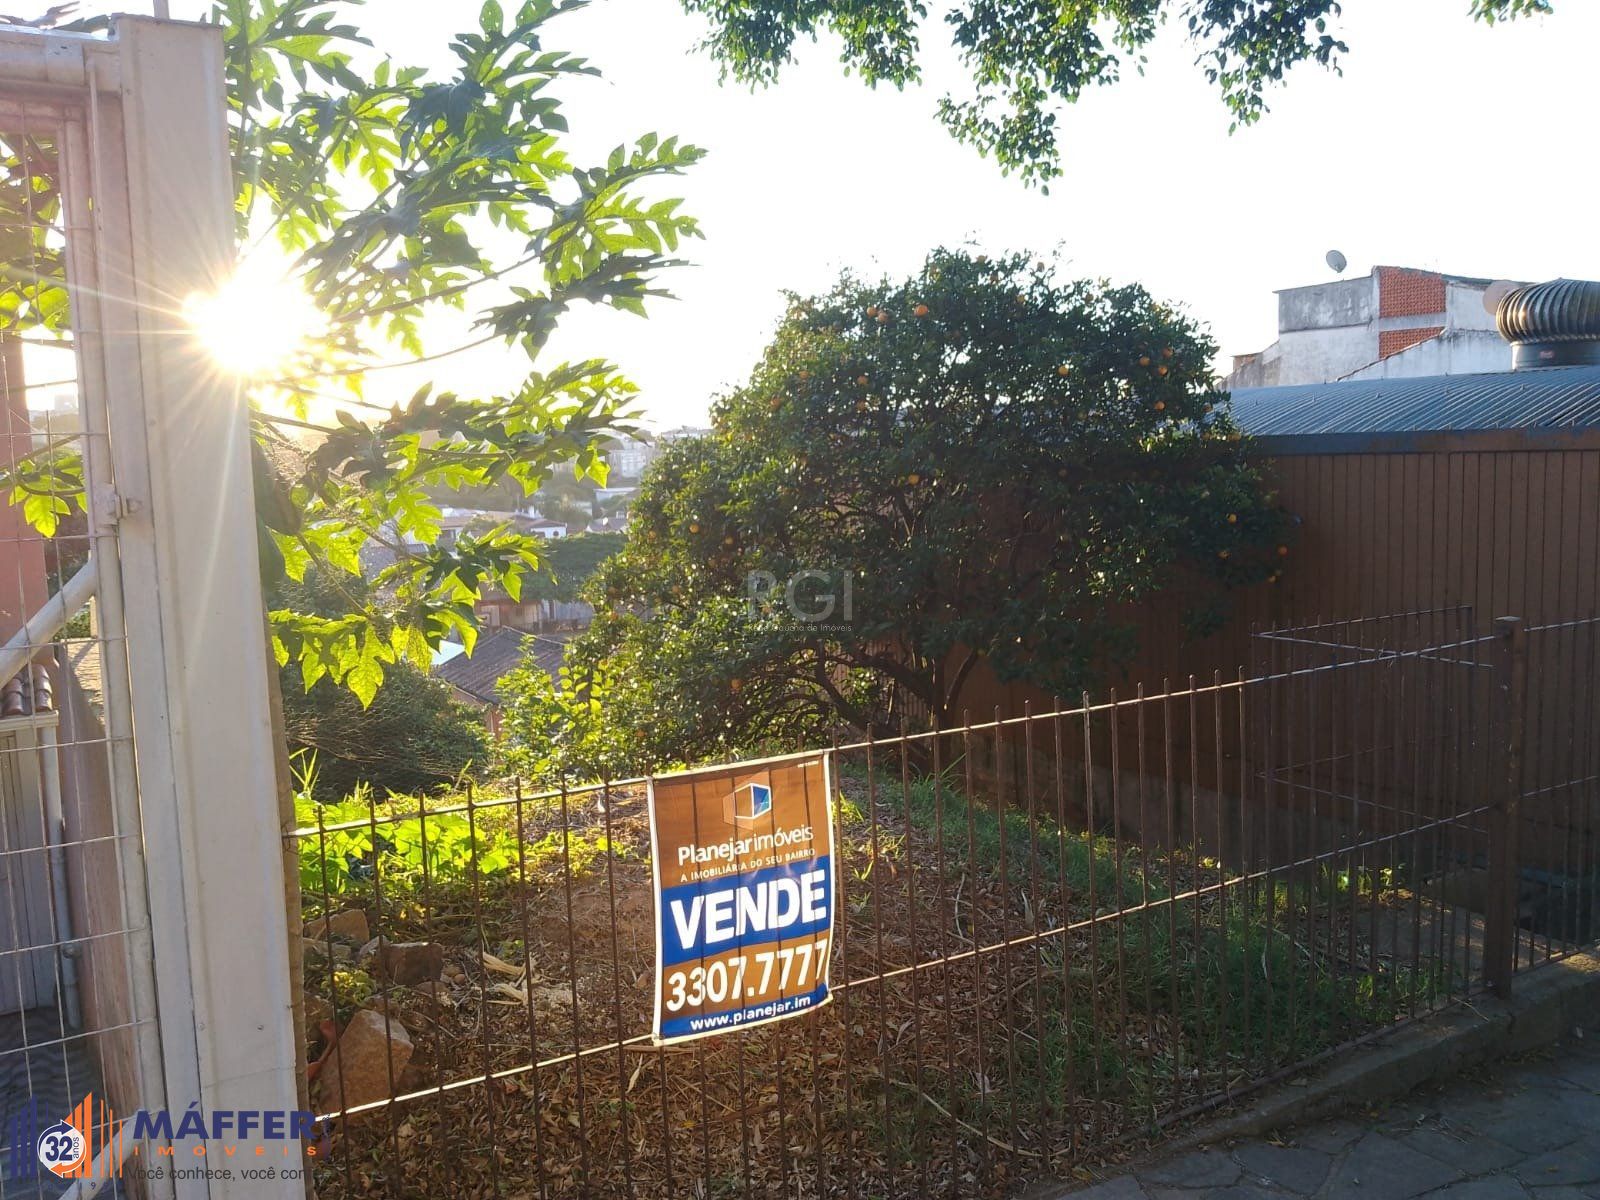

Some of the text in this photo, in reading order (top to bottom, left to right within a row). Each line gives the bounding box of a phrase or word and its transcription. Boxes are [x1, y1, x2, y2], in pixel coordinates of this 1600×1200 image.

[680, 874, 688, 883] A
[750, 859, 763, 869] DO
[765, 854, 783, 866] SEU
[785, 848, 815, 862] BAIRRO
[670, 869, 827, 950] VENDE
[666, 938, 828, 1012] 3307.7777
[690, 996, 811, 1031] www.planejar.im
